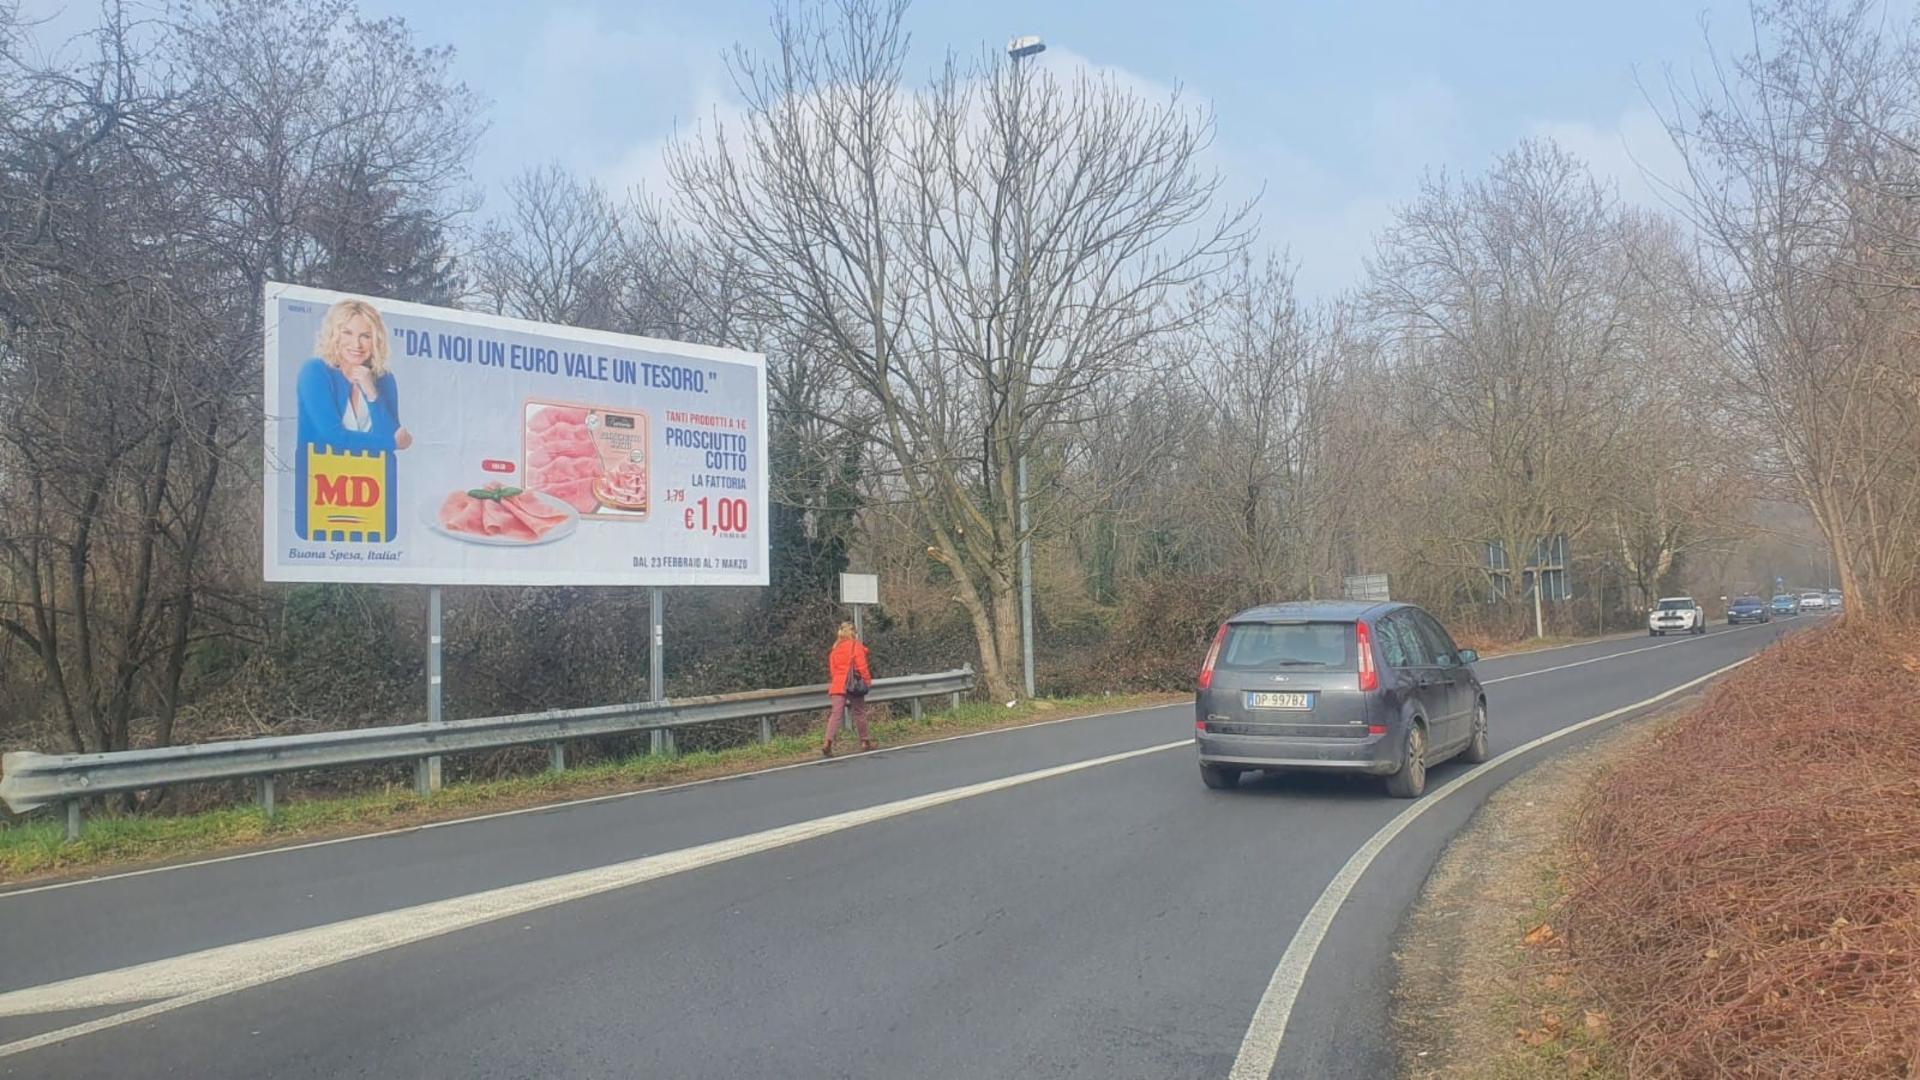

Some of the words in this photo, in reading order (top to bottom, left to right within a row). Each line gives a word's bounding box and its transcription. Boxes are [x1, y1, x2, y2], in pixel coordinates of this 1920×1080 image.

[438, 333, 473, 363] NOI
[478, 339, 505, 368] UN
[511, 344, 559, 375] EURO
[564, 352, 608, 381] VALE
[612, 358, 637, 384] UN
[666, 410, 688, 423] TANTI
[690, 413, 727, 428] PRODOTTI
[666, 427, 746, 453] PROSCIUTTO
[706, 450, 747, 472] COTTO
[314, 474, 380, 507] MD
[692, 474, 703, 487] LA
[705, 475, 746, 490] FATTORIA
[684, 508, 694, 530] €
[697, 496, 747, 536] 1,00
[288, 548, 326, 559] Buona
[633, 556, 648, 568] DAL
[651, 556, 662, 568] 23
[663, 556, 701, 568] FEBBRAIO
[703, 557, 713, 569] AL
[722, 558, 748, 570] MARZO
